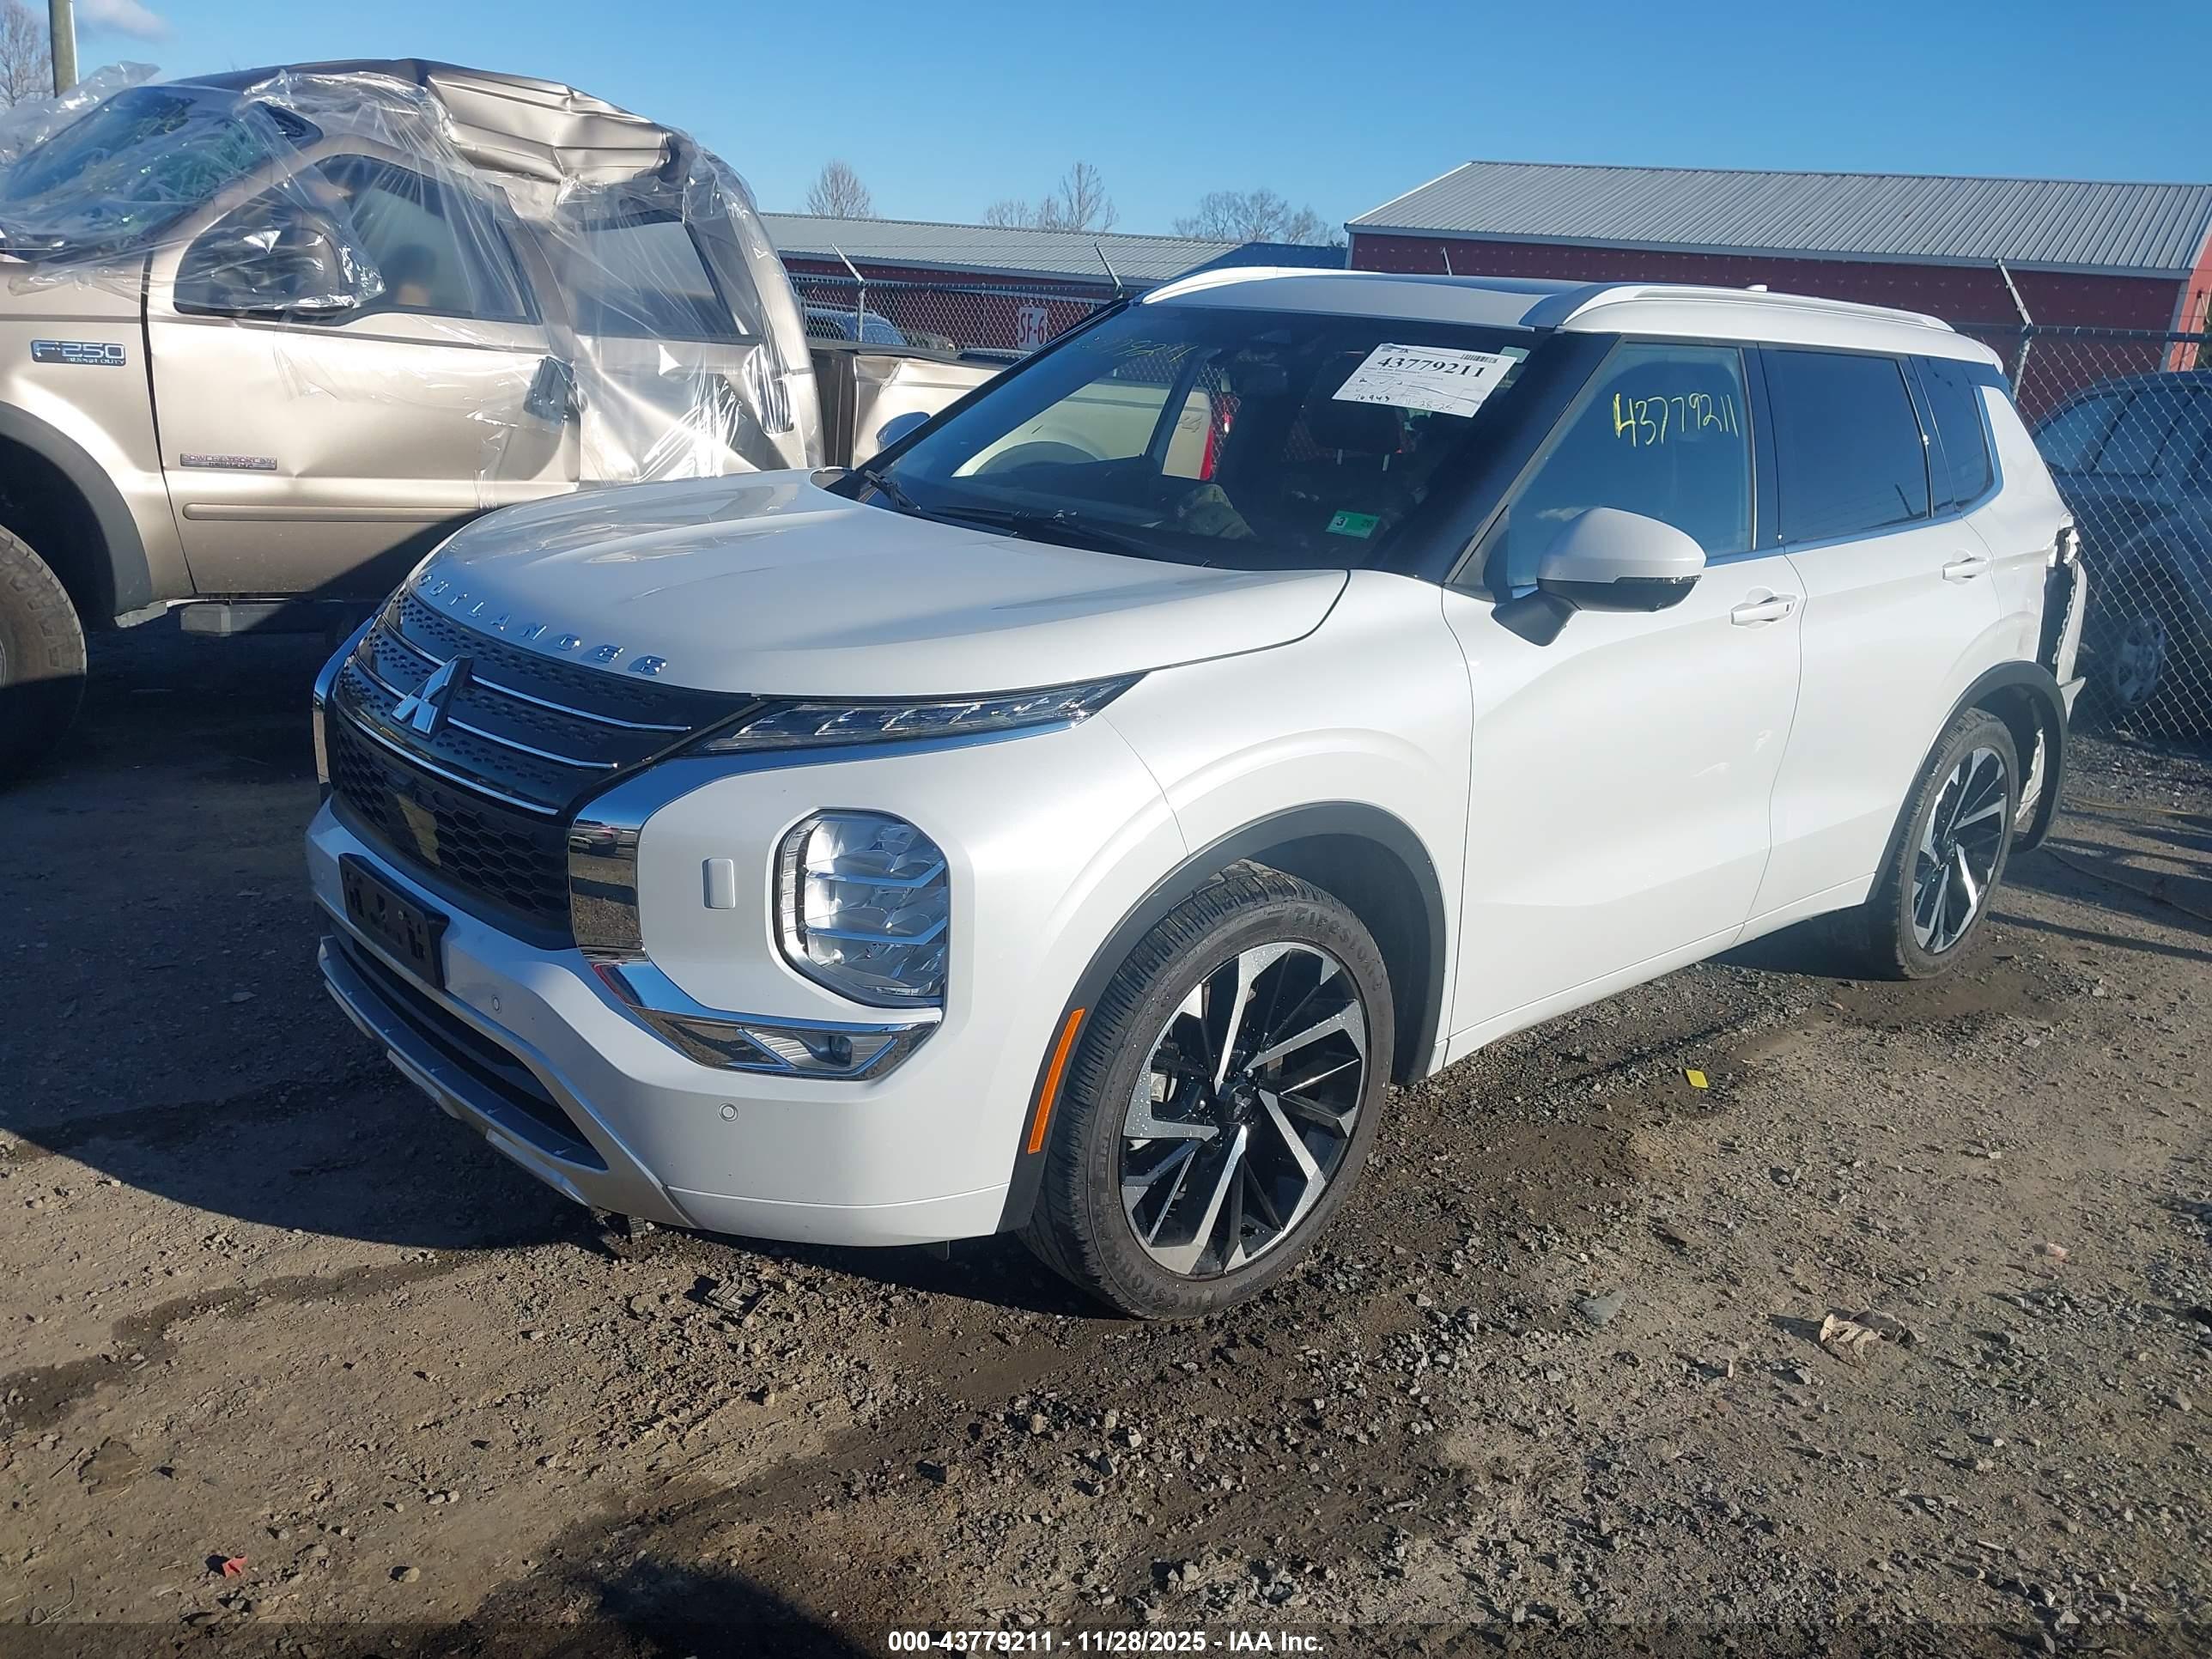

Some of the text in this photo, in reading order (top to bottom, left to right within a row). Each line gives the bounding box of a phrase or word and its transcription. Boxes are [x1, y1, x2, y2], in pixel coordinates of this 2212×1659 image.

[1019, 313, 1045, 344] SF-6
[1377, 356, 1486, 378] 43779211
[1613, 392, 1740, 447] 43779211
[1336, 516, 1346, 526] 3
[418, 574, 667, 676] OUTLANDER
